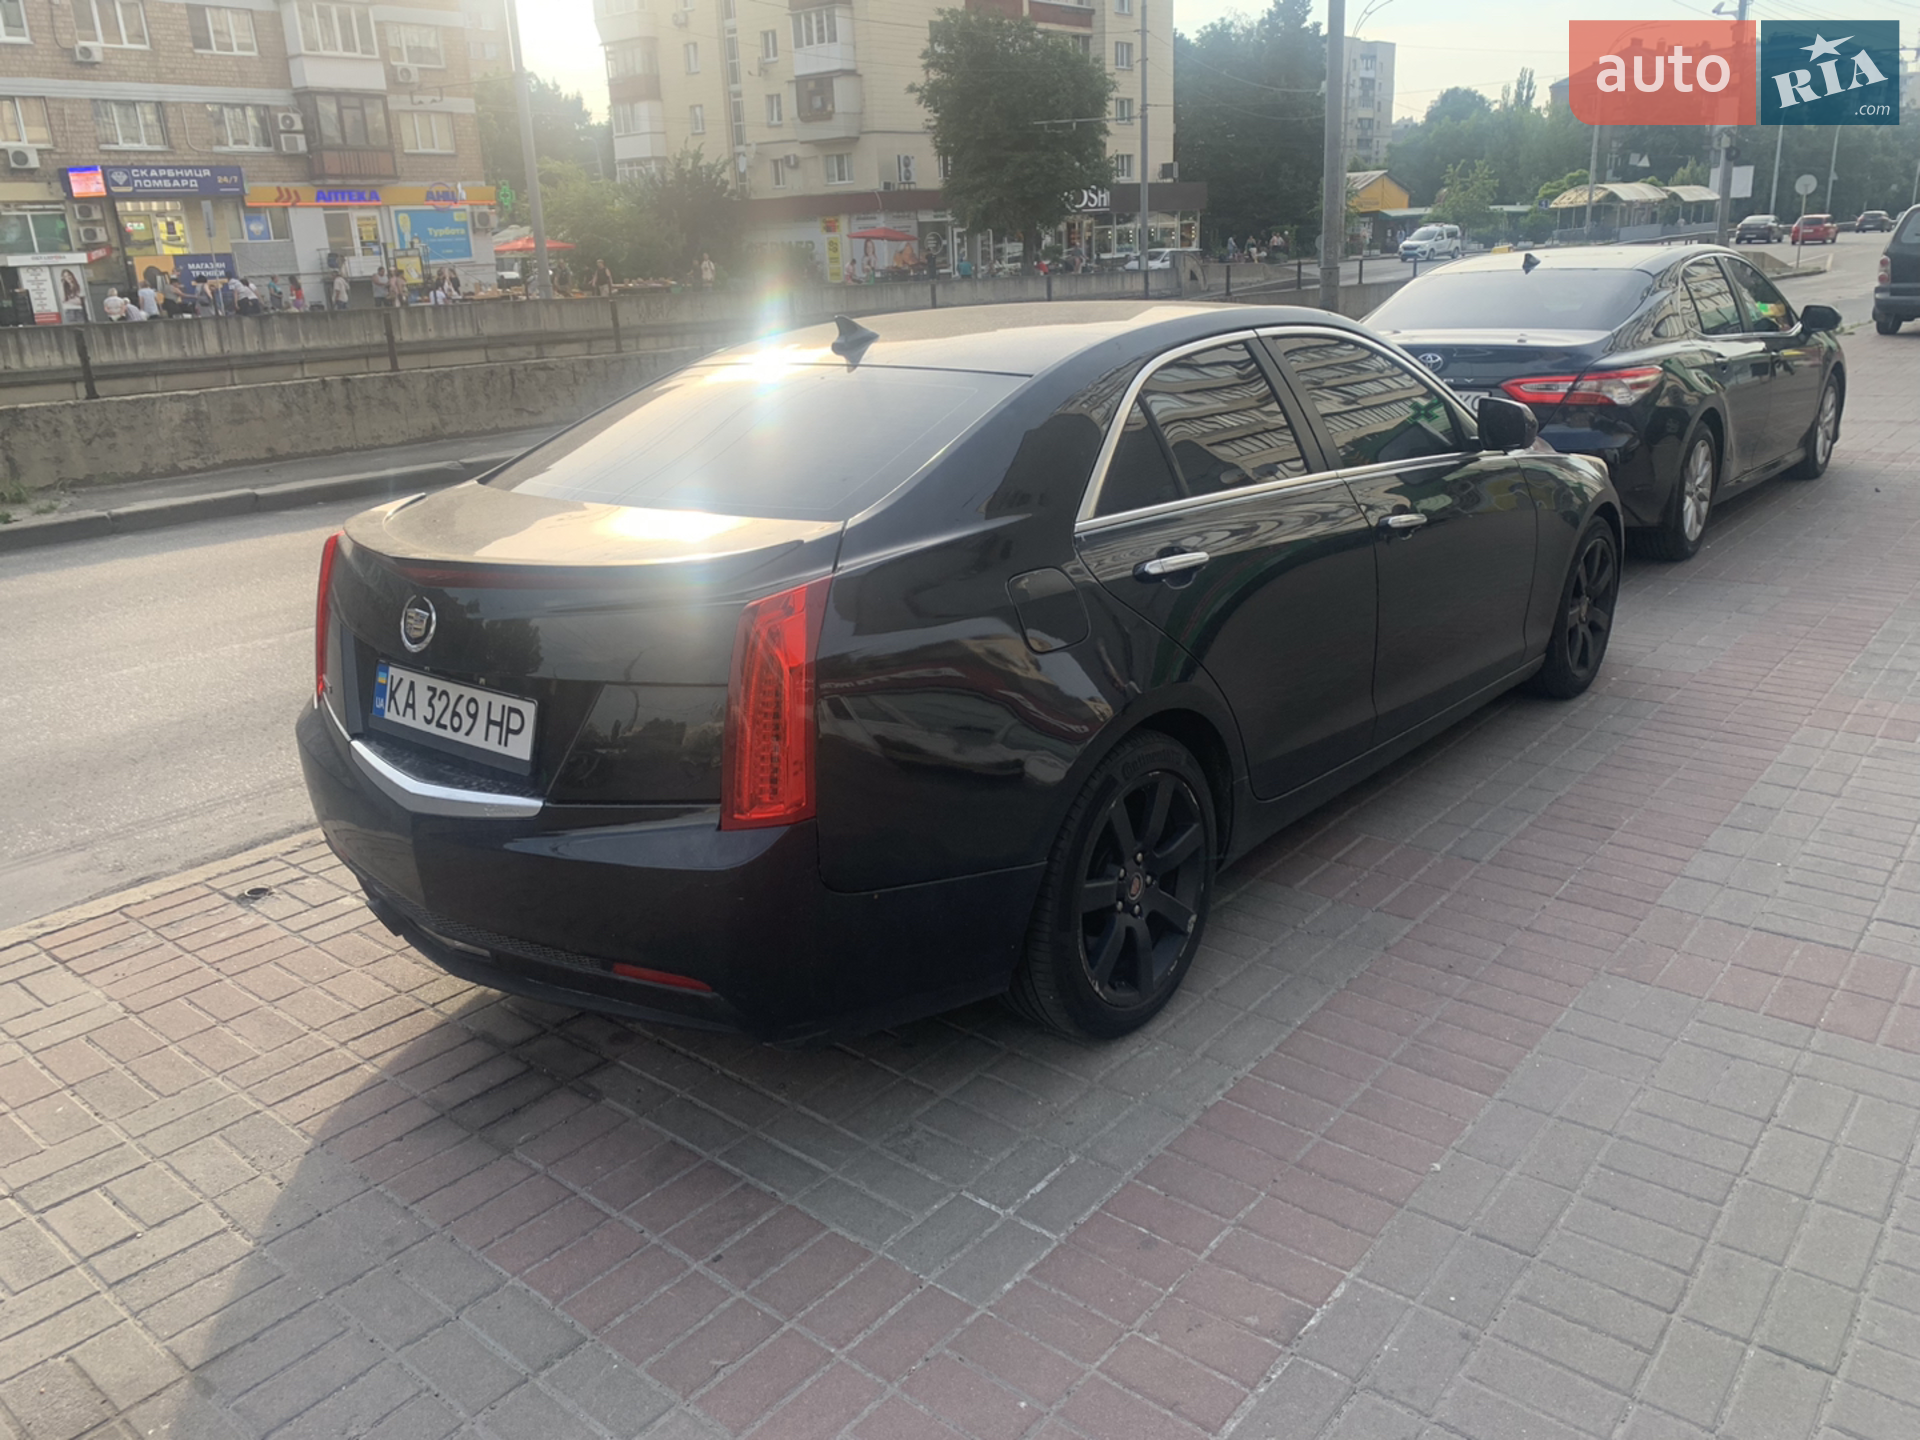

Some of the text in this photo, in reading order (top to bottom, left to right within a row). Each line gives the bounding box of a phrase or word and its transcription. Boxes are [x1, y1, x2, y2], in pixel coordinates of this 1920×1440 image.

[131, 168, 211, 179] СКАРБНИЦЯ
[133, 178, 199, 188] ЛОМБАРД
[217, 175, 239, 184] 24/7
[316, 190, 380, 203] АПТЕКА
[387, 674, 526, 748] KA 3269 HP
